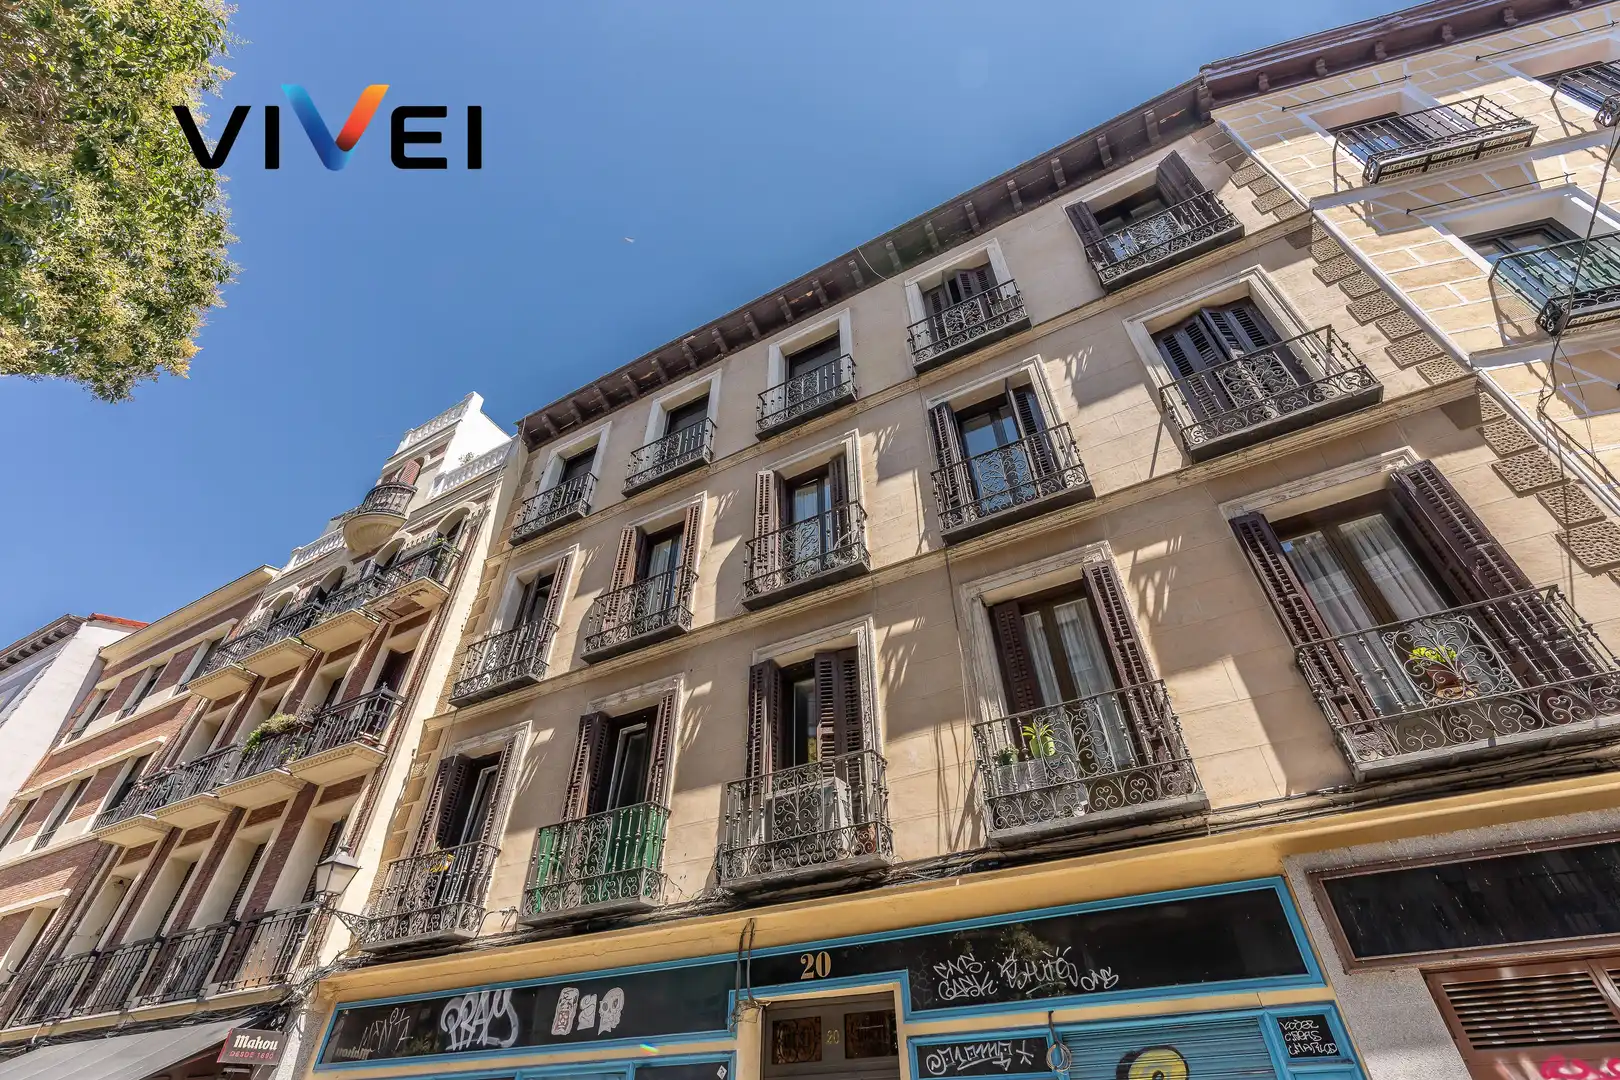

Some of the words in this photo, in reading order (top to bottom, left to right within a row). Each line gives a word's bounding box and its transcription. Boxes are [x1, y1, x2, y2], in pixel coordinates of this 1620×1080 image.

[800, 951, 832, 980] 20
[233, 1034, 279, 1051] Mahou
[826, 1029, 840, 1045] 20
[229, 1050, 255, 1058] DESDE
